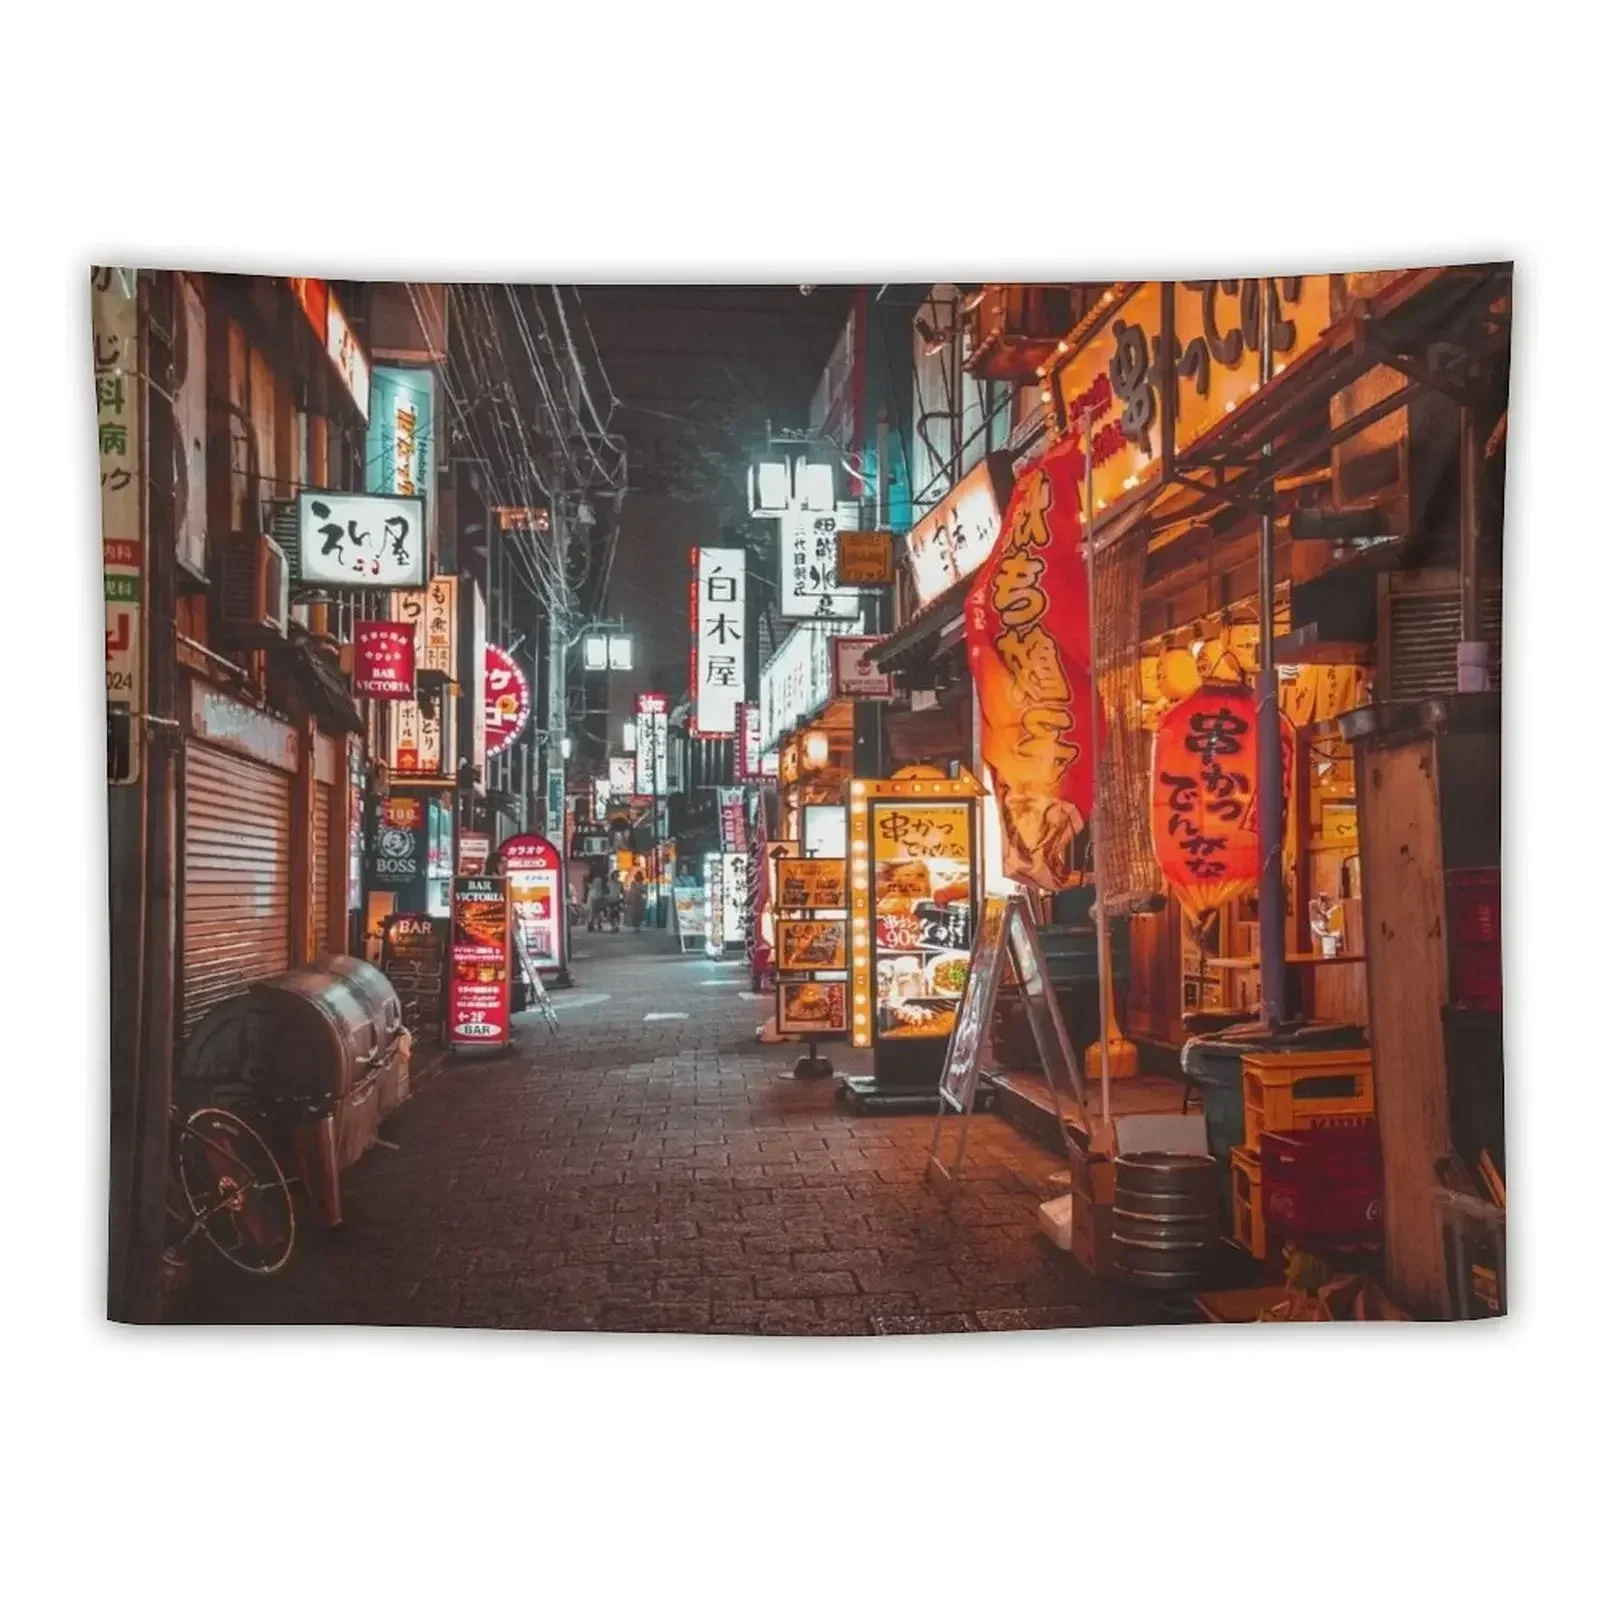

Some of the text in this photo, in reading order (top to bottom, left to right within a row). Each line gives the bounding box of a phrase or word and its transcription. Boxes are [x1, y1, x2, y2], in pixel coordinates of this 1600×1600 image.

[705, 566, 741, 688] 白木屋
[372, 668, 396, 679] BAR
[485, 668, 512, 690] ケ
[356, 680, 412, 693] VICTORIA
[1184, 708, 1249, 820] 串かつ
[880, 811, 954, 843] 串かつ
[376, 859, 416, 873] BOSS
[468, 880, 492, 890] BAR
[454, 891, 505, 902] VICTORIA
[399, 920, 432, 934] BAR
[464, 1025, 491, 1035] BAR
